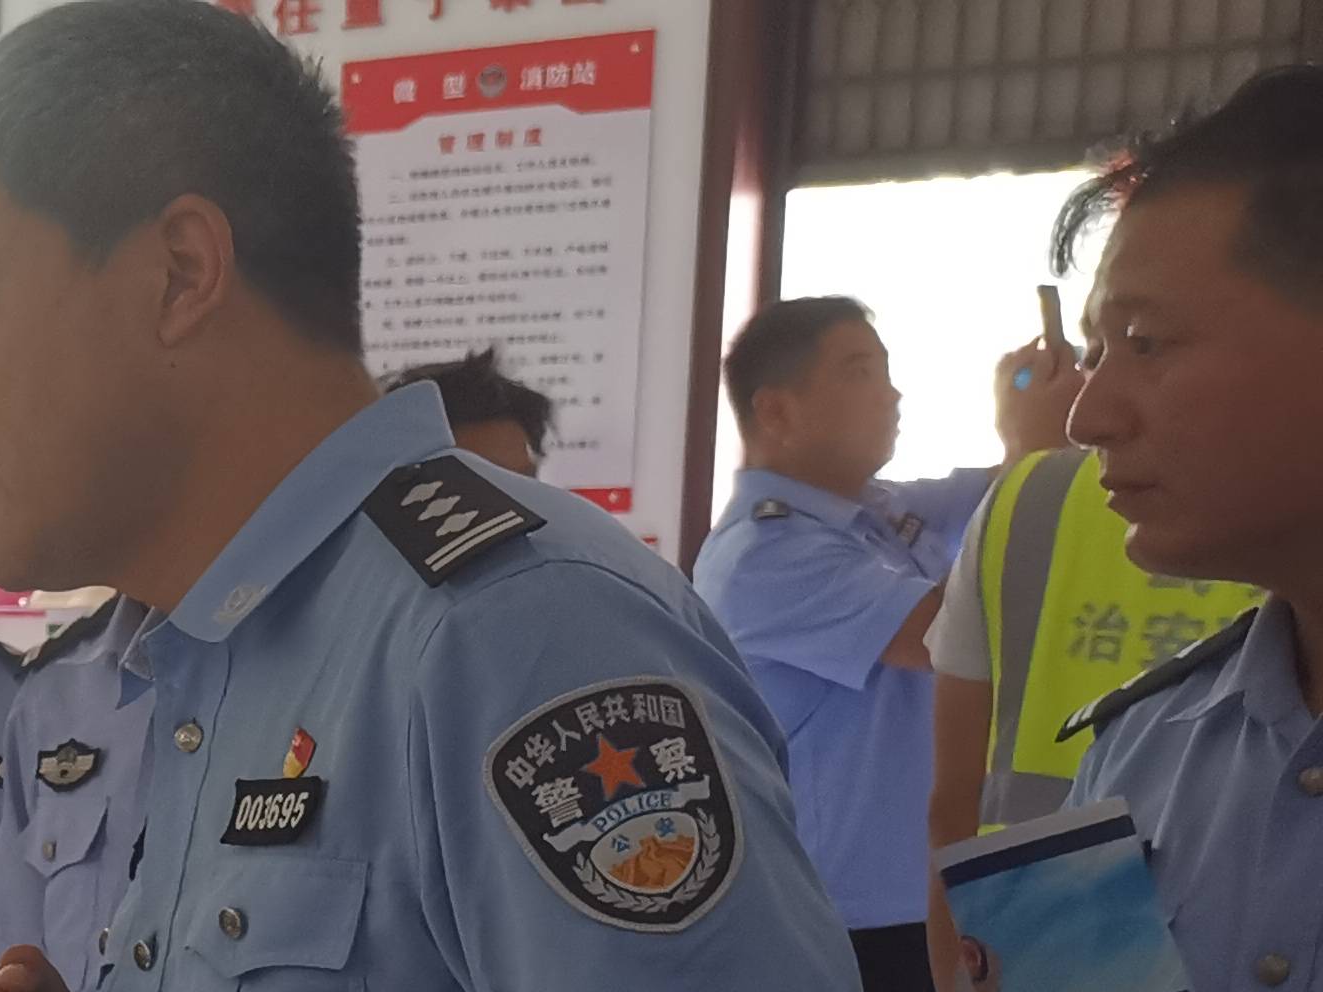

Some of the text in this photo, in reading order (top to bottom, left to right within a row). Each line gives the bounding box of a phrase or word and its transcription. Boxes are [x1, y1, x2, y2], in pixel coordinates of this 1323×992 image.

[504, 693, 687, 790] 中华人民共和国
[592, 788, 673, 834] POLICE
